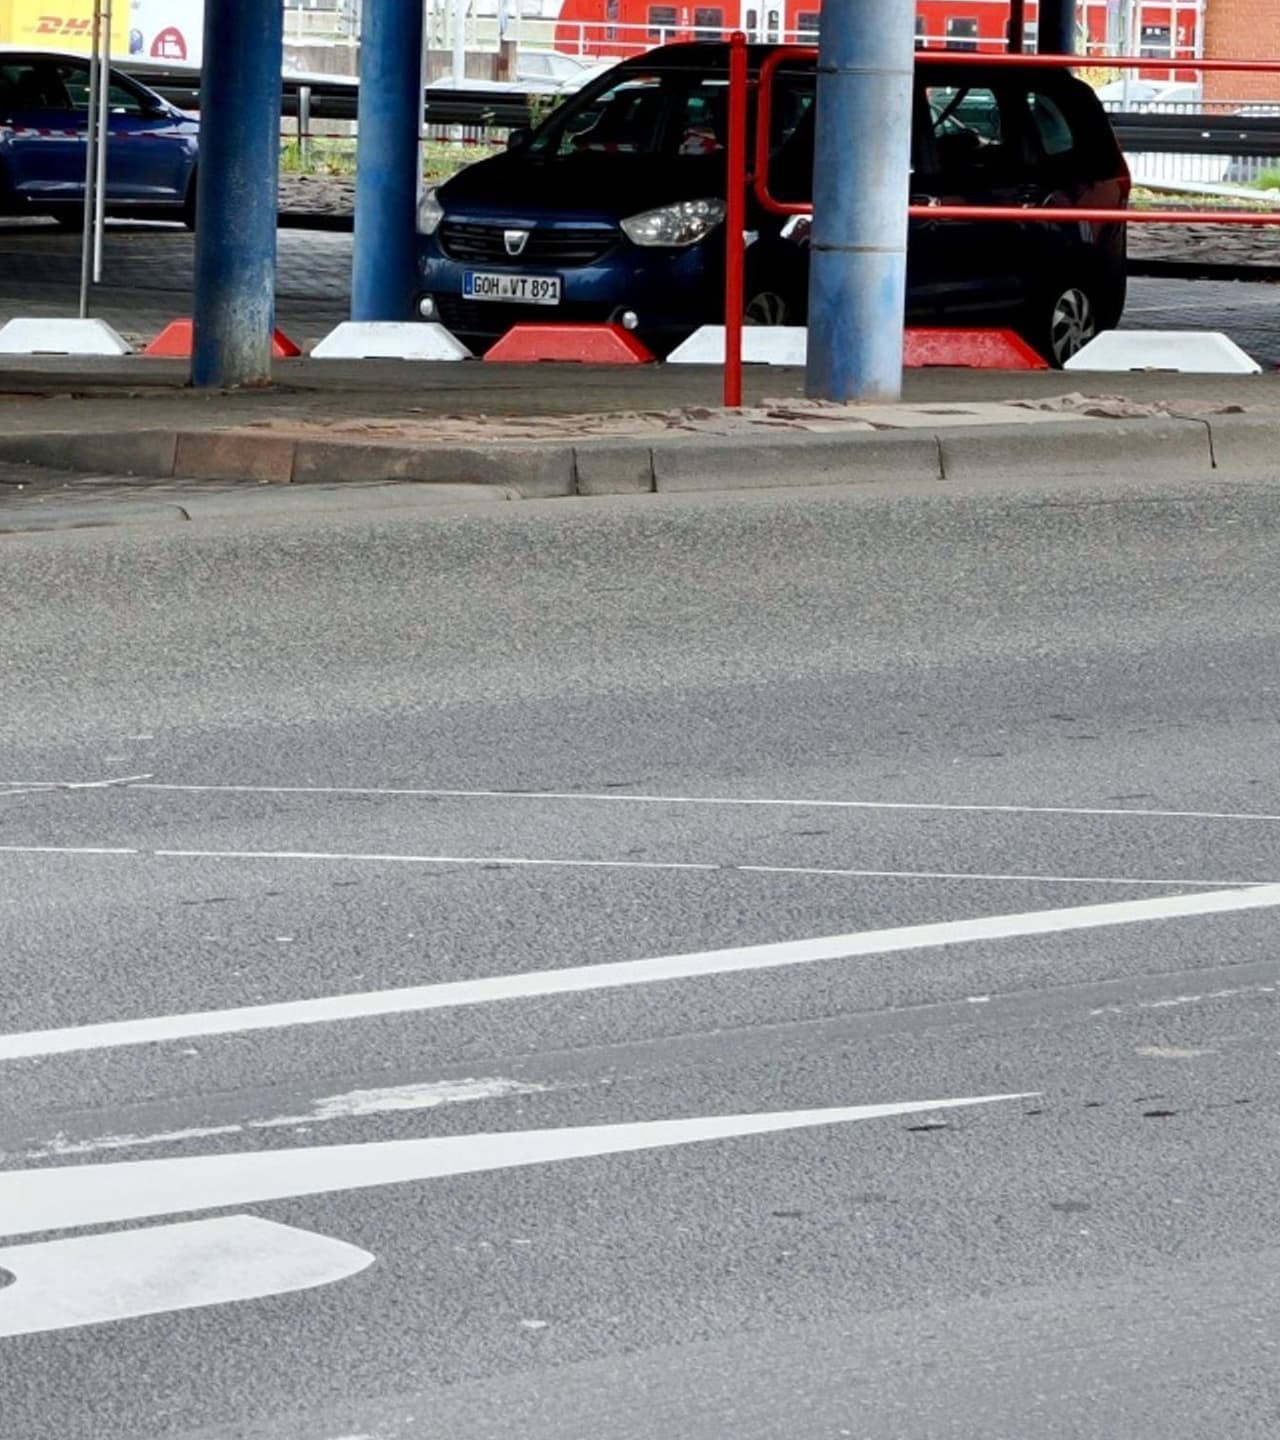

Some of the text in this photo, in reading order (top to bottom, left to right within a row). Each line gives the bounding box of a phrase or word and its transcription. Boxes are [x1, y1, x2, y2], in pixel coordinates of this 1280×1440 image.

[473, 275, 558, 299] GOH VT 891
